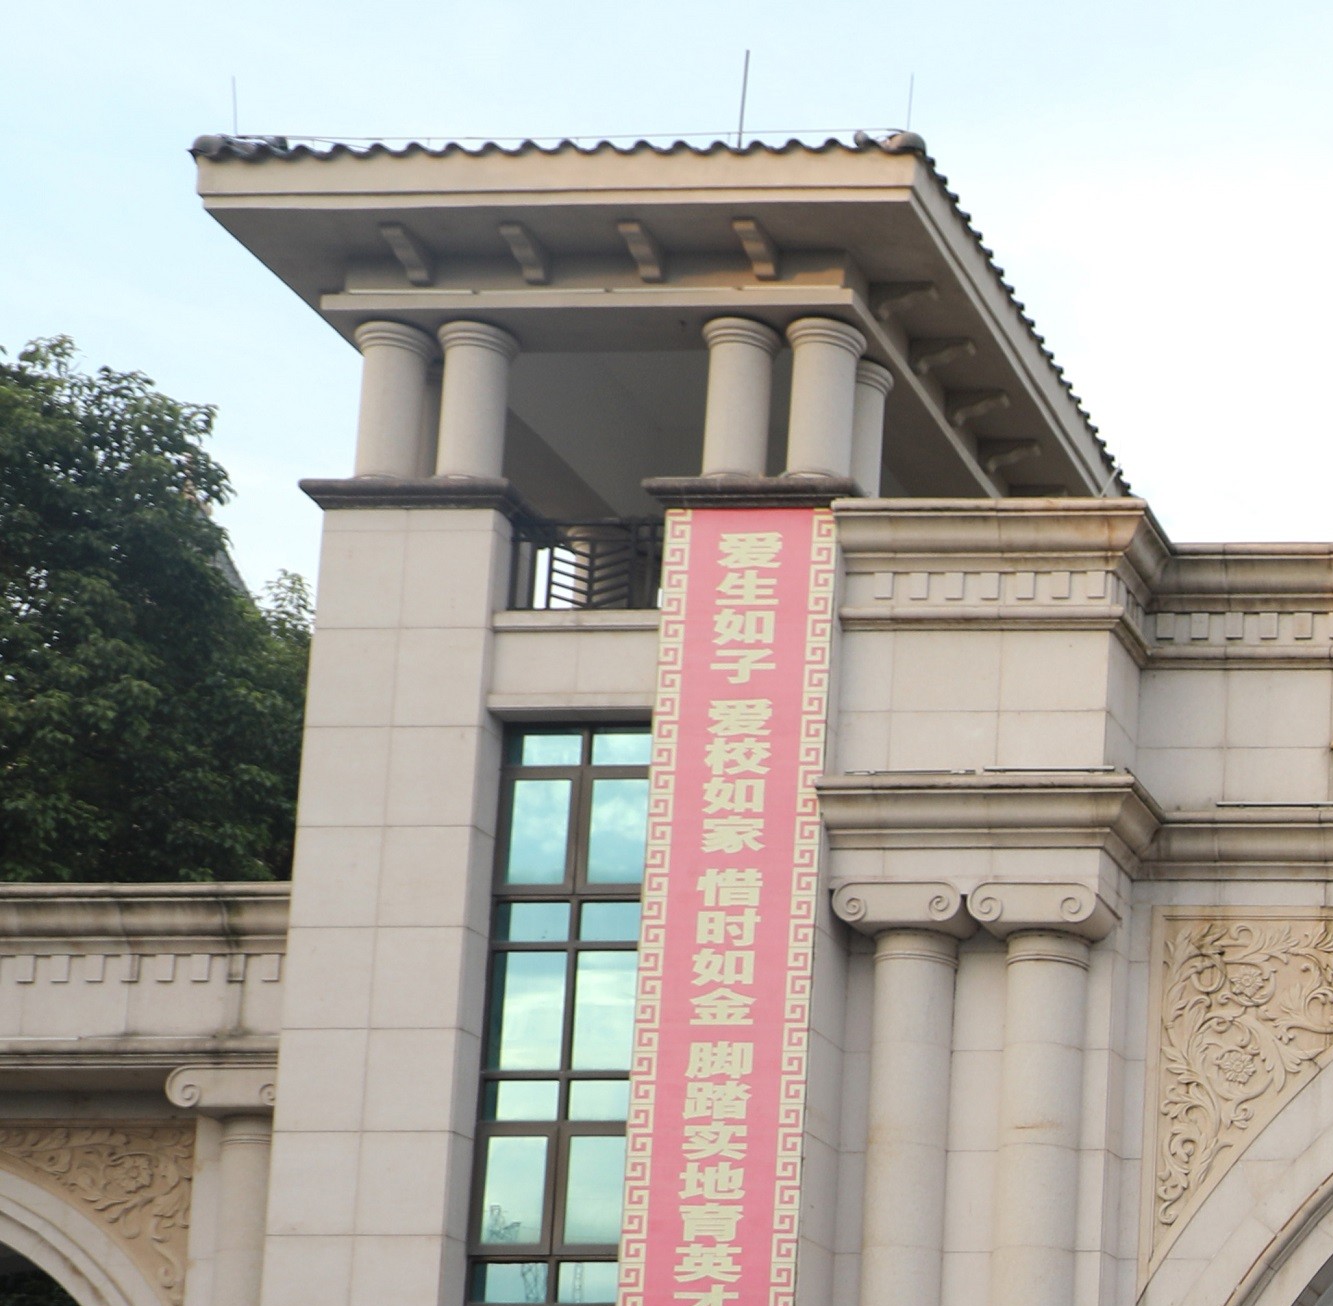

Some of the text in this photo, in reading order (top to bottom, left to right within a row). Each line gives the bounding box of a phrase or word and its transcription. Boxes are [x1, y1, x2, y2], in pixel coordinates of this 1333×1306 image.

[710, 531, 783, 685] 爱生如子
[702, 697, 773, 855] 爱校如家
[689, 868, 764, 1026] 惜时如金
